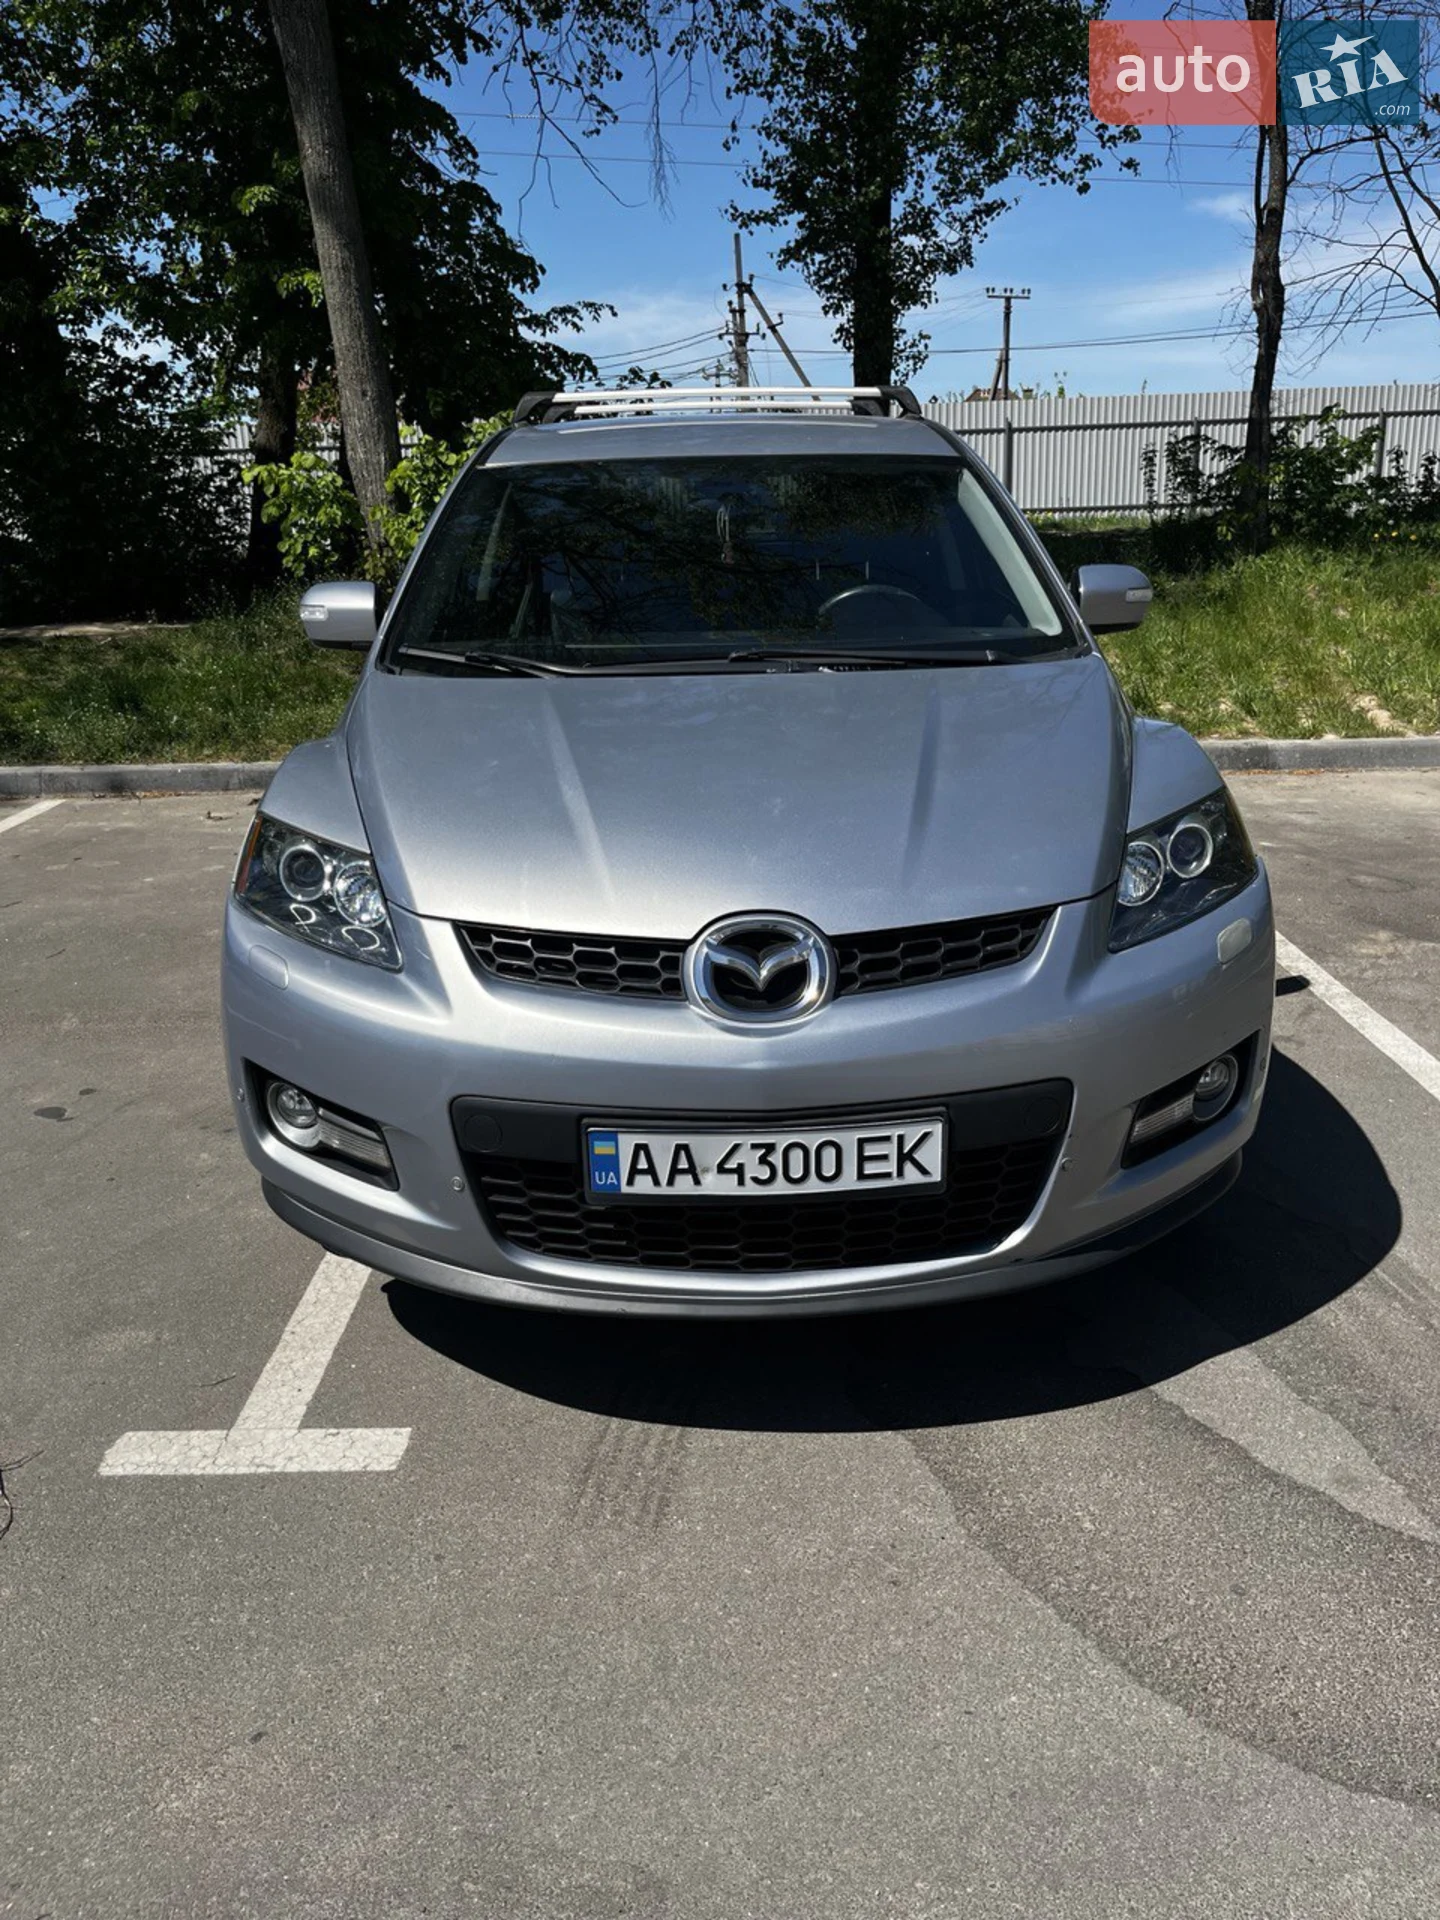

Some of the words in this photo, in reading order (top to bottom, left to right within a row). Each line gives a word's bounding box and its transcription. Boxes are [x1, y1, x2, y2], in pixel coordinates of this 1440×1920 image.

[625, 1142, 702, 1187] AA
[716, 1139, 844, 1187] 4300
[856, 1130, 933, 1181] EK
[594, 1170, 618, 1185] UA
